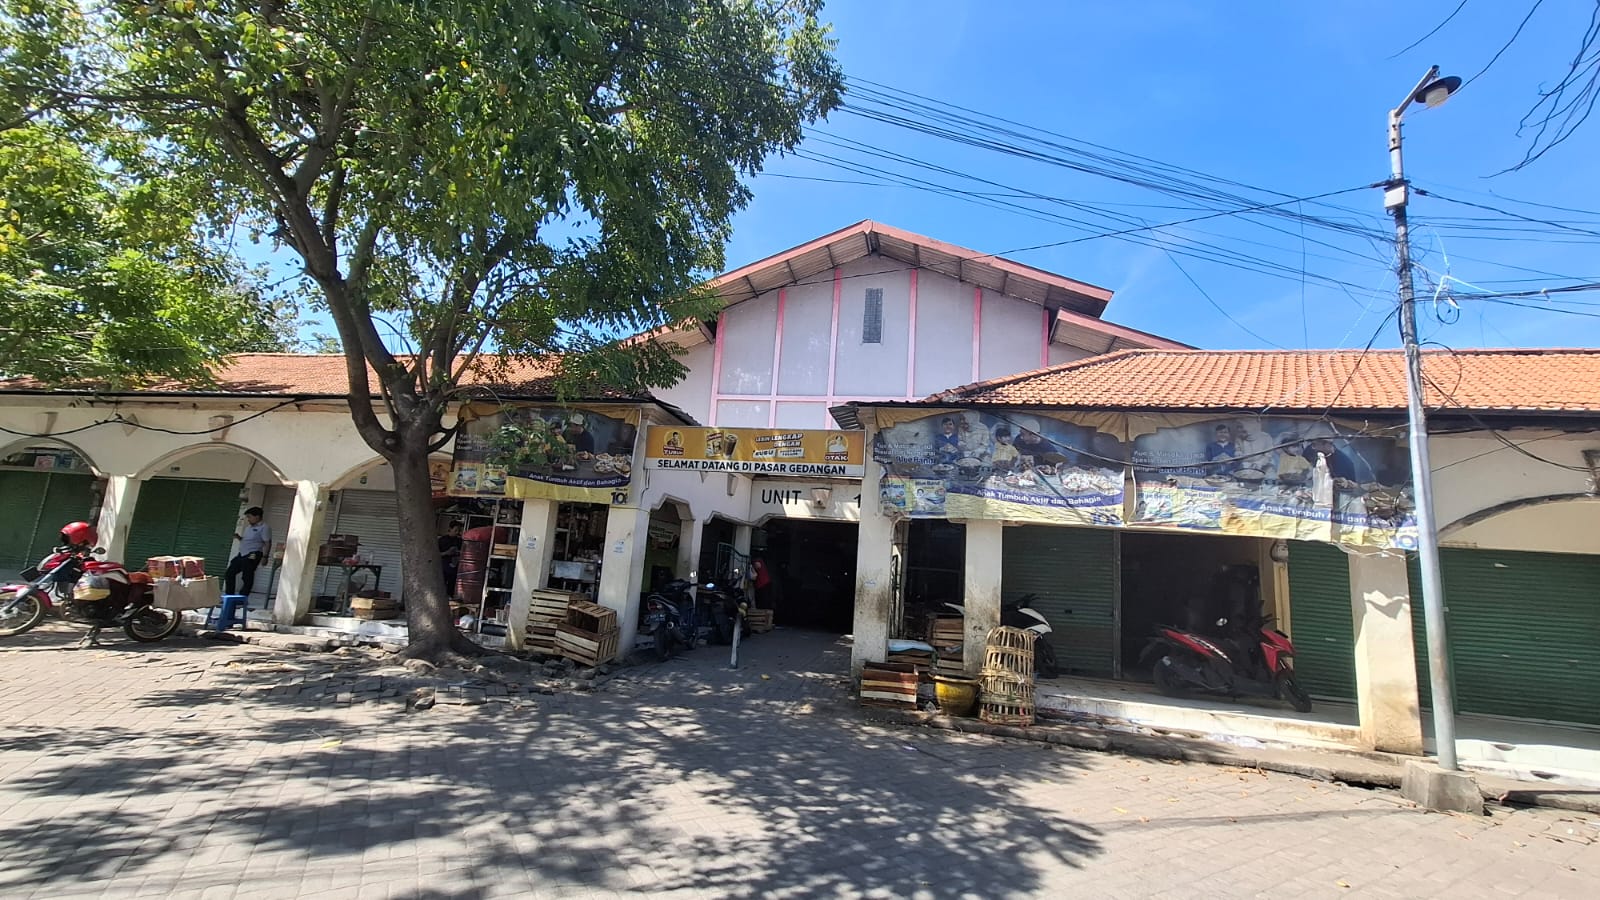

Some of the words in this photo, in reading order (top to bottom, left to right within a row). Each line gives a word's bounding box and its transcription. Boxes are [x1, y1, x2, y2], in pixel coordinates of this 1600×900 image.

[771, 433, 803, 442] LENGKAP
[657, 459, 700, 469] SELAMAT
[701, 460, 740, 471] DATANG
[742, 462, 752, 470] DI
[754, 463, 787, 472] PASAR
[789, 464, 846, 474] GEDANGAN
[761, 489, 802, 505] UNIT
[976, 490, 995, 498] Anak
[998, 492, 1029, 502] Tumbuh
[1259, 503, 1284, 512] Anak
